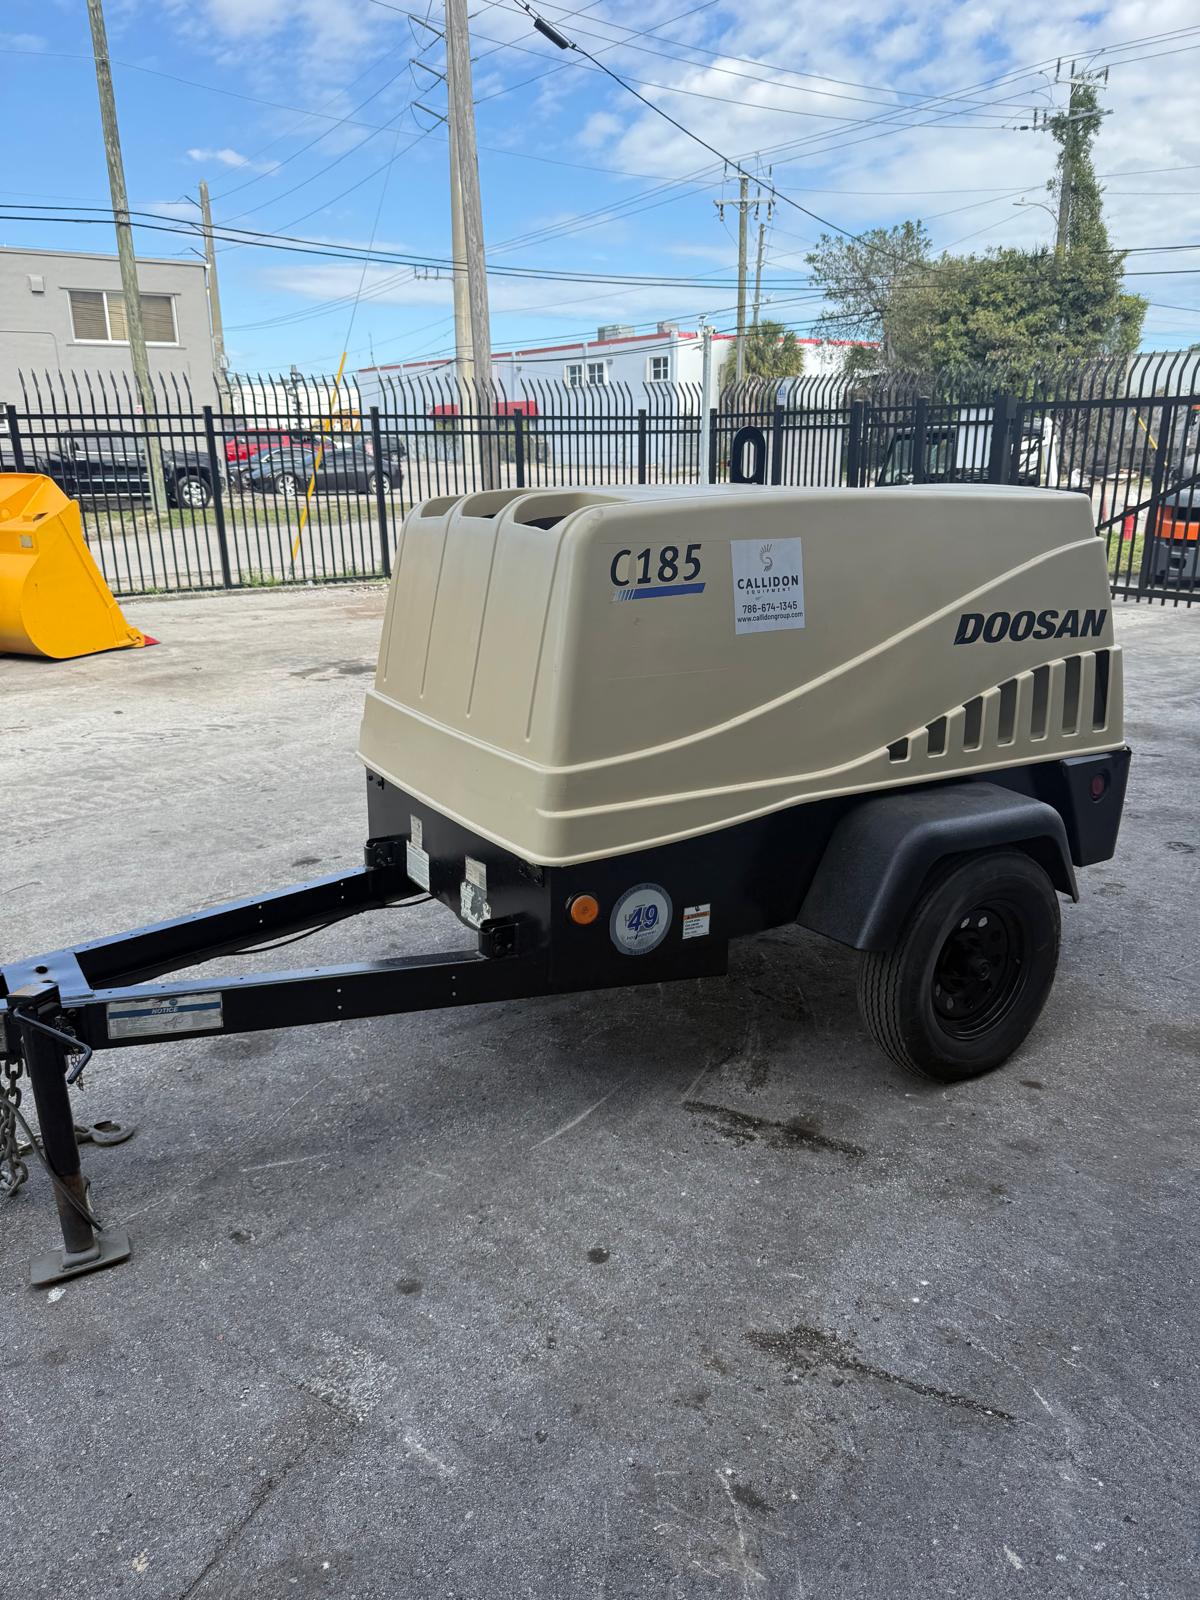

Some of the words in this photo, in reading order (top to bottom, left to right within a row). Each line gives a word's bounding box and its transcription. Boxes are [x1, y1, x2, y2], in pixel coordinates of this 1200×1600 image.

[610, 543, 702, 587] C185
[737, 575, 799, 590] CALLIDON
[746, 587, 791, 595] EQUIPMENT
[742, 600, 798, 614] 786-674-1345
[737, 612, 804, 623] www.callidongroup.com
[954, 608, 1108, 646] DOOSAN
[627, 904, 658, 931] 49
[151, 1006, 179, 1016] NOTICE
